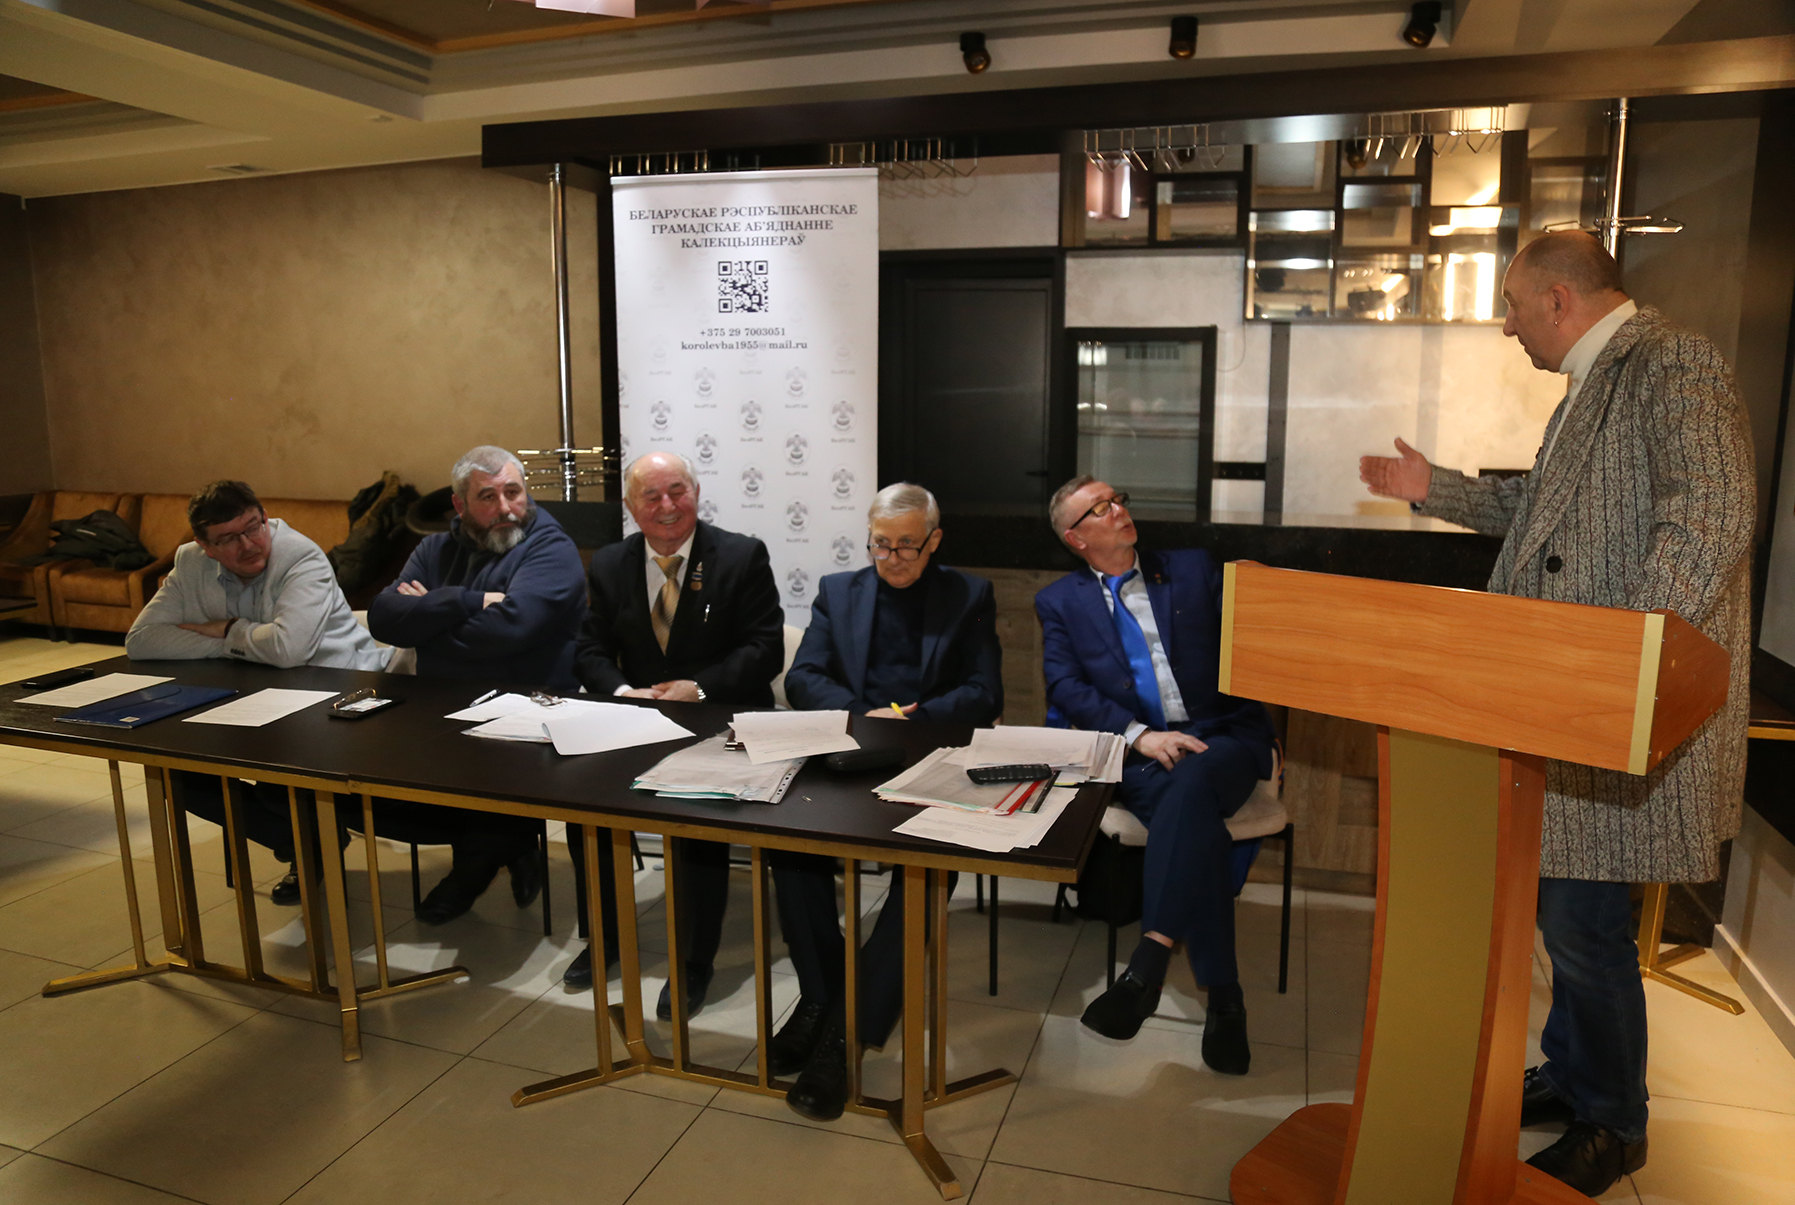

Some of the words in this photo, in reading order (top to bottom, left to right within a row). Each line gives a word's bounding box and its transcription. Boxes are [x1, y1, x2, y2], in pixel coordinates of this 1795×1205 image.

[629, 207, 717, 220] БЕЛАРУСКАЕ
[721, 204, 858, 218] РЭСПУБЛІКАНСКАЕ
[651, 222, 741, 235] ГРАМАДСКАЕ
[681, 233, 806, 249] КАЛЕКЦЫЯНЕРАЎ
[700, 327, 726, 337] +375
[728, 327, 741, 337] 29
[744, 327, 786, 337] 7003051
[681, 339, 808, 351] korolevba1955@mail.ru
